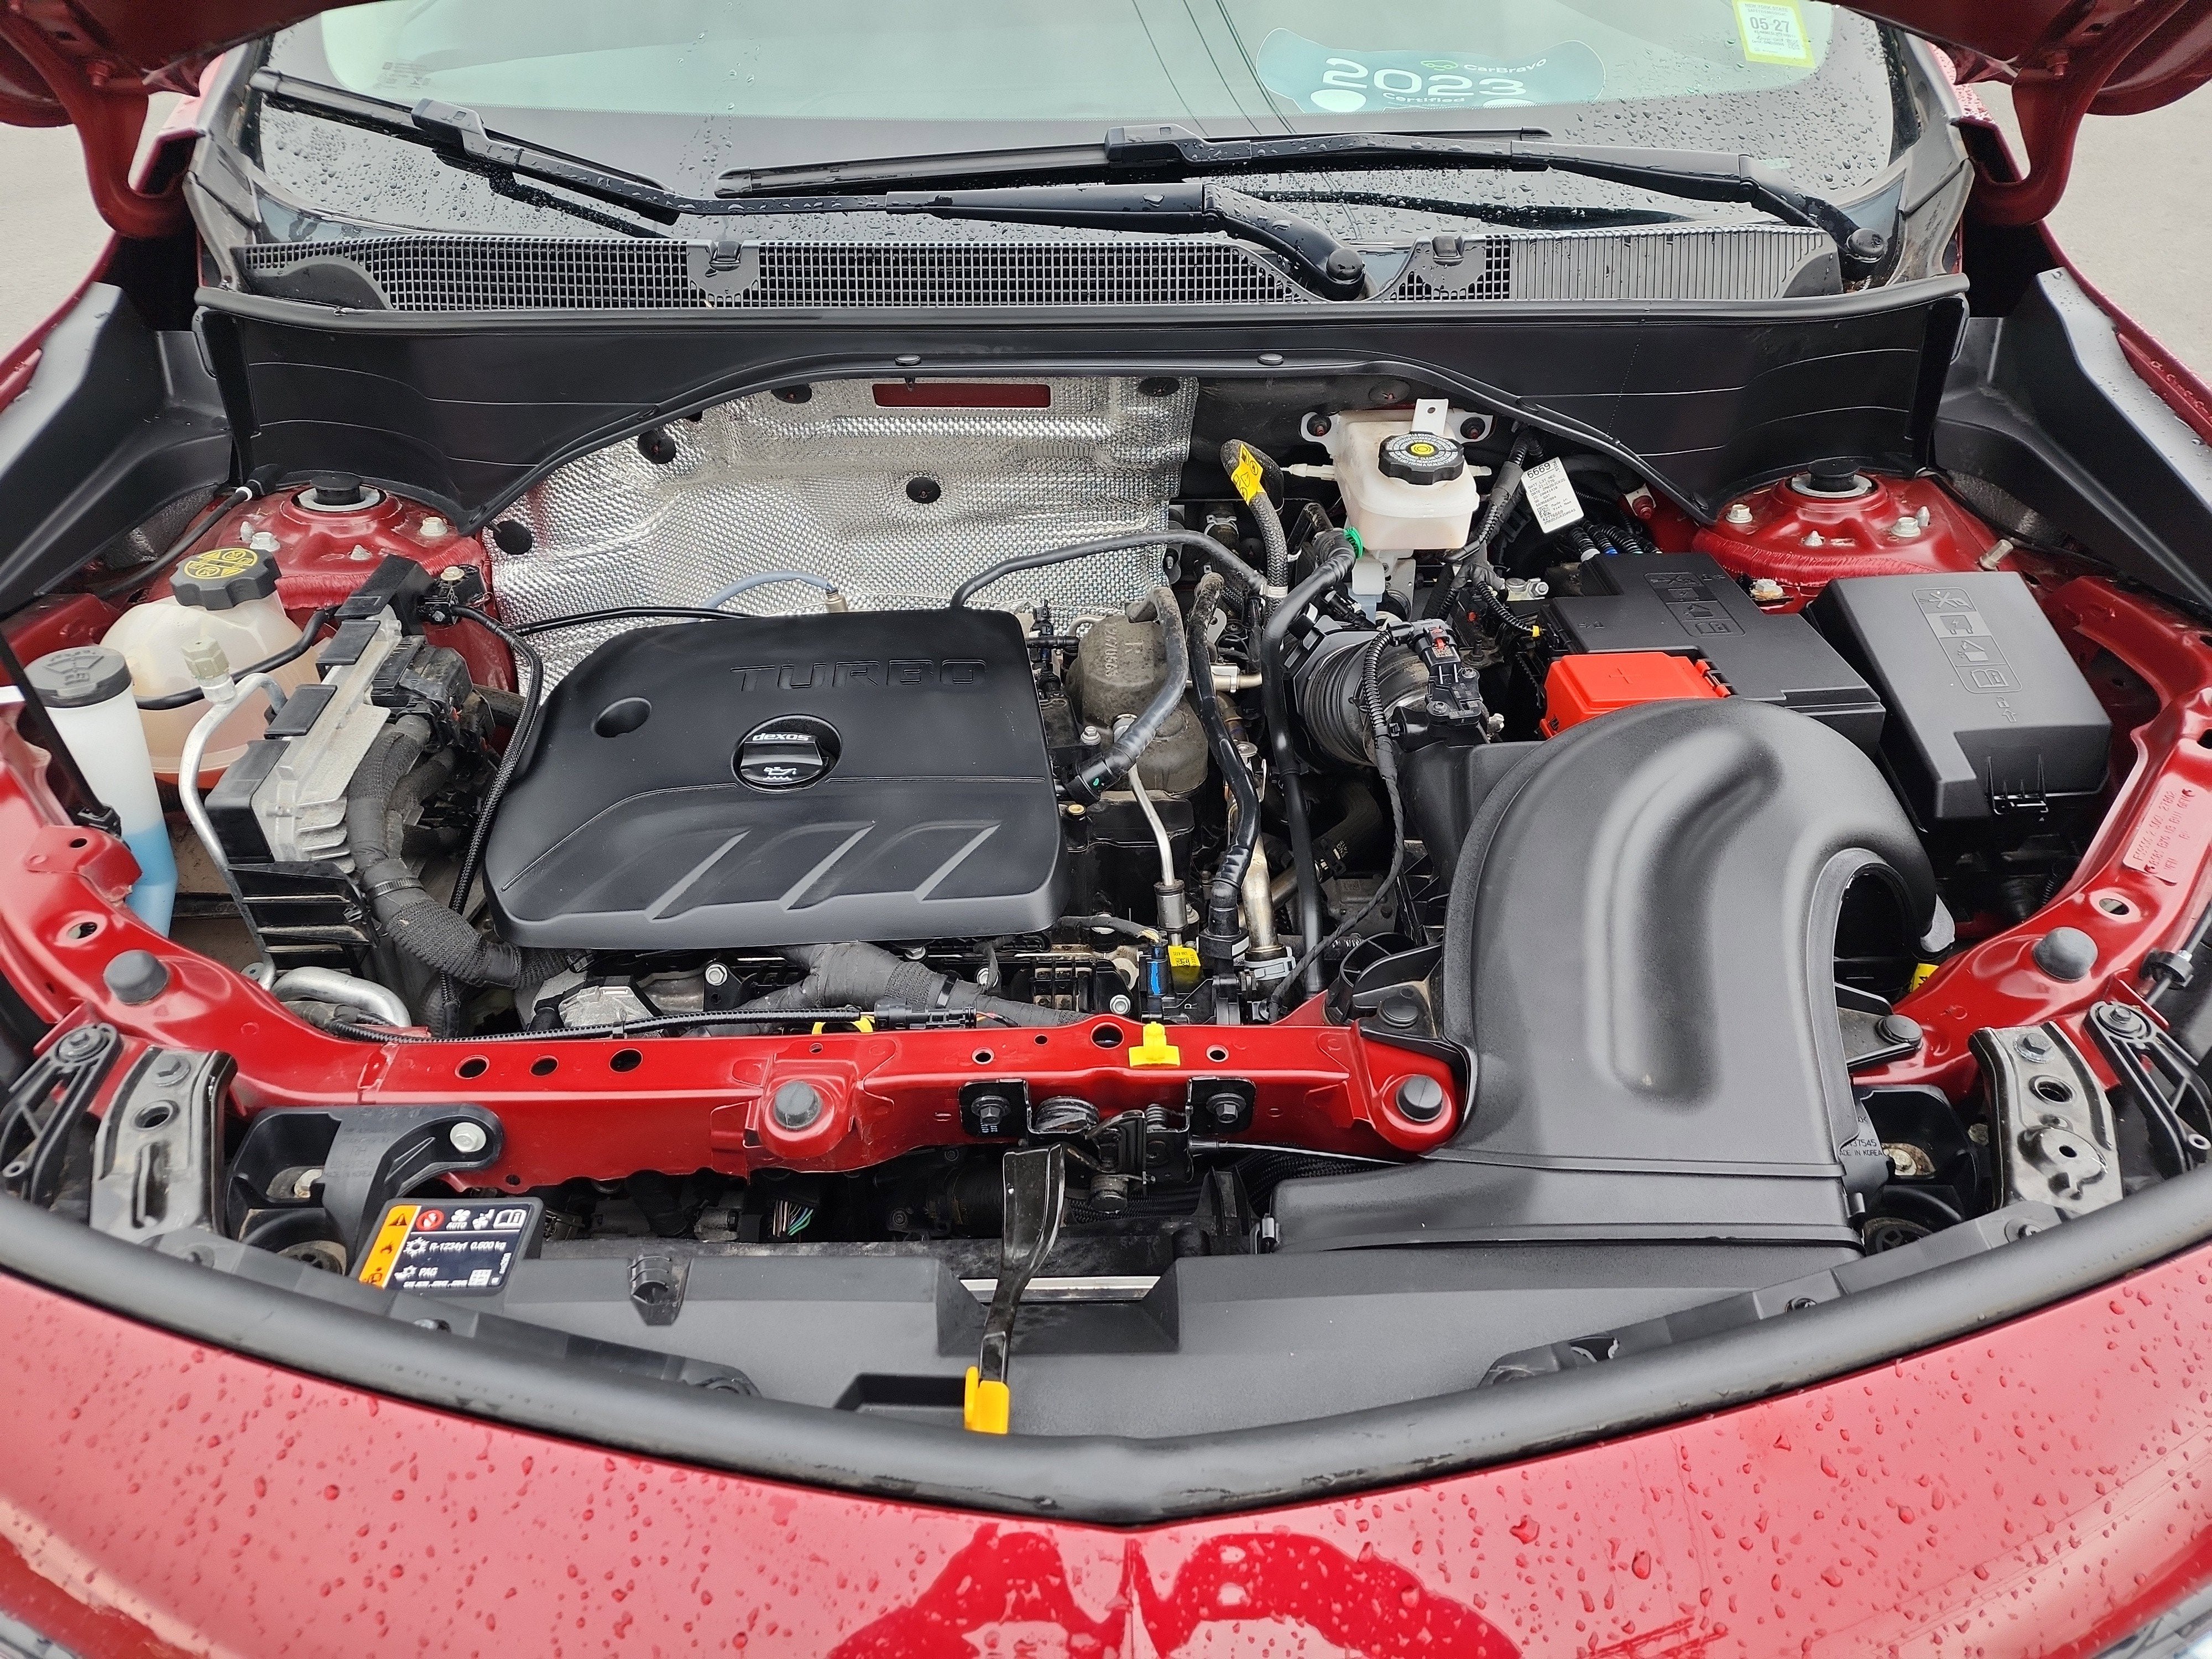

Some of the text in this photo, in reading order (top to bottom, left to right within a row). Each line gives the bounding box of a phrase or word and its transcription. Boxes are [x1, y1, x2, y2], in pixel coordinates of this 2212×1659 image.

[1464, 59, 1547, 73] CarBravo
[1322, 58, 1526, 96] 2023
[1383, 92, 1465, 103] Certified
[1527, 462, 1551, 478] 6669
[731, 659, 987, 691] TURBO
[752, 733, 812, 742] dexos
[446, 1222, 467, 1230] AUTO
[494, 1241, 507, 1252] kg
[418, 1267, 438, 1278] PAG
